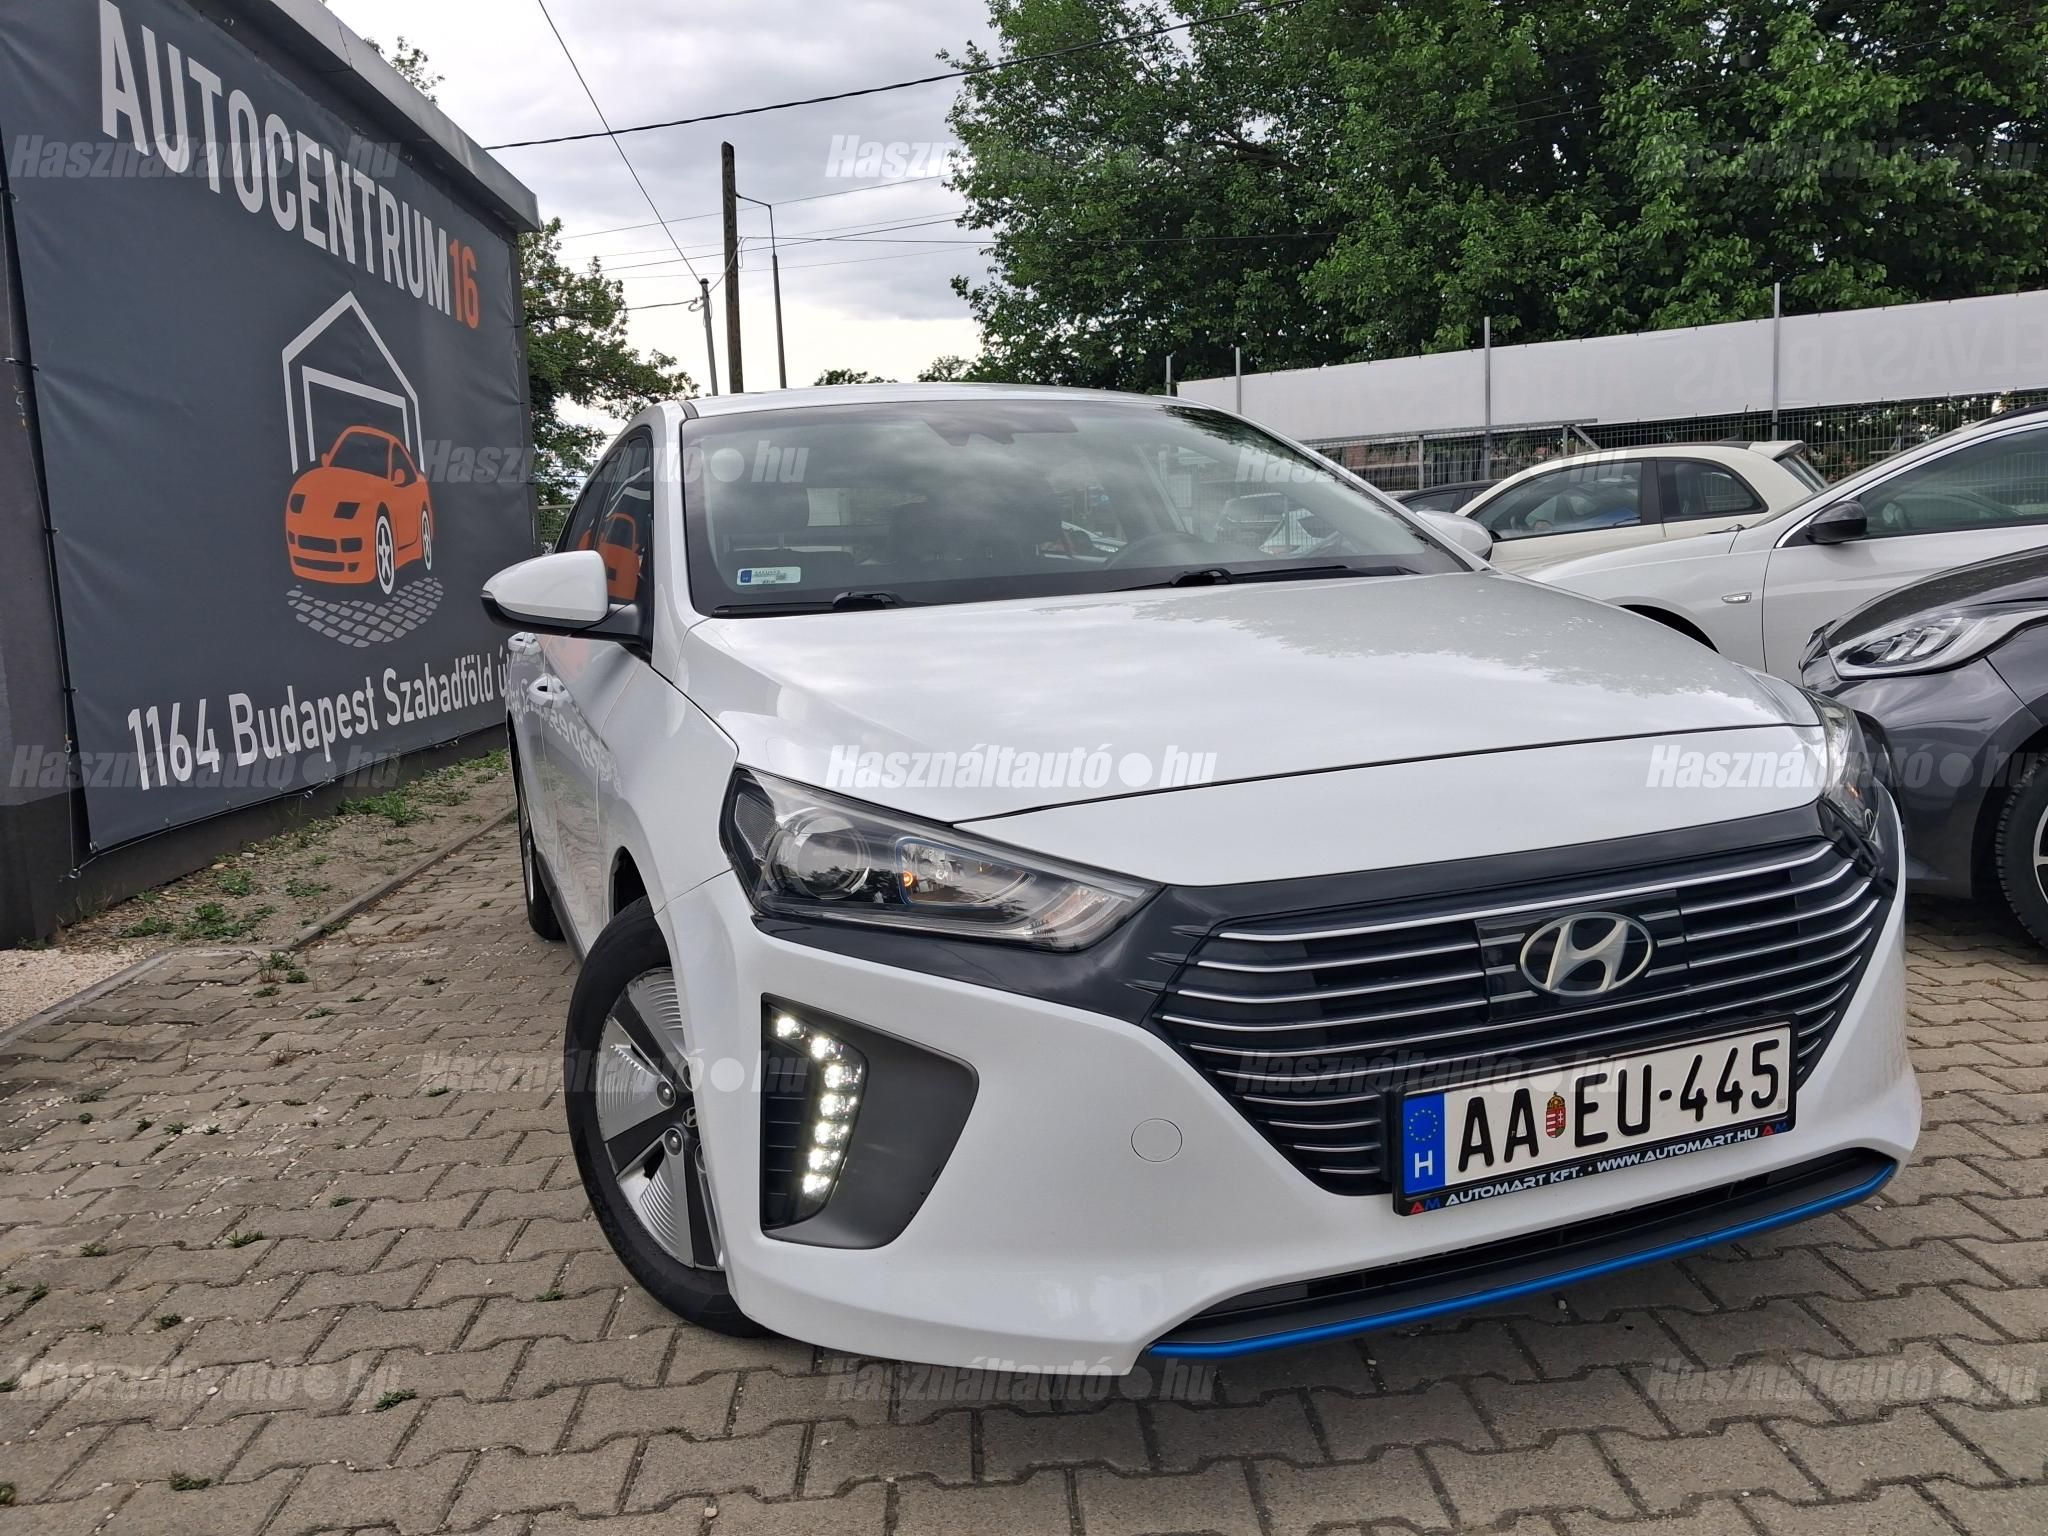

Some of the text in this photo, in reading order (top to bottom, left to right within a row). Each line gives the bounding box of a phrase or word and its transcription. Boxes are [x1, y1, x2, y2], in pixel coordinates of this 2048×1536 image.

[127, 644, 510, 790] 1164 Budapest Szabadföld ú
[1414, 1150, 1433, 1178] H
[1445, 1174, 1546, 1207] AUTOMART
[1550, 1165, 1584, 1186] KFT.
[1596, 1127, 1759, 1173] WWW.AUTOMART.HU
